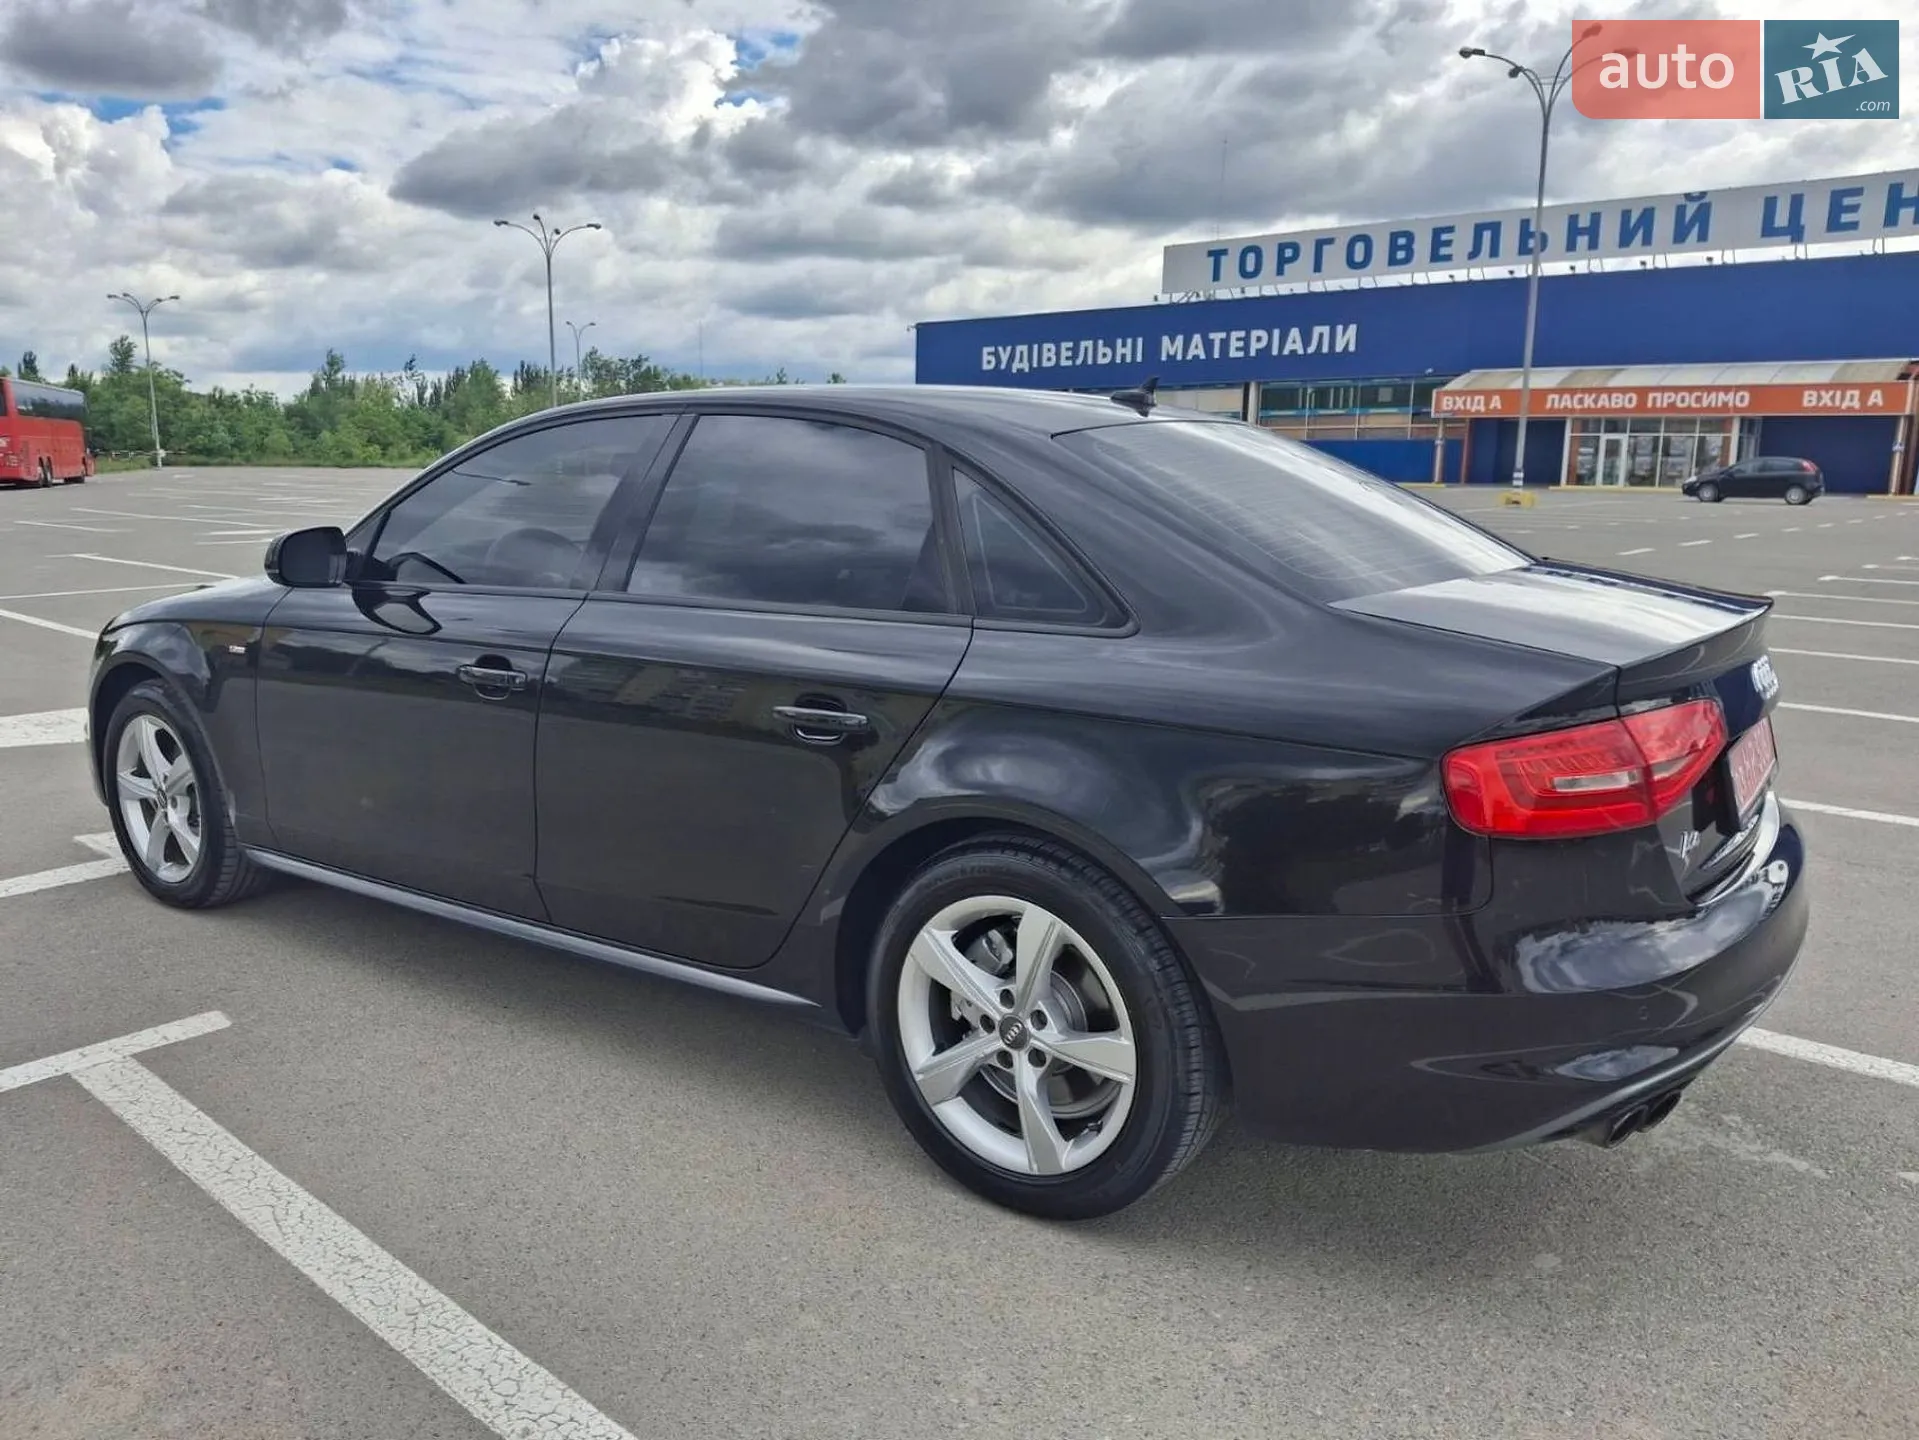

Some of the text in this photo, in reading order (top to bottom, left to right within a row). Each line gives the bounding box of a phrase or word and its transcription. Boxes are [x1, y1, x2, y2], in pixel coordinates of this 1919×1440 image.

[1207, 191, 1712, 282] ТОРГОВЕЛЬНИЙ
[982, 324, 1358, 373] БУДІВЕЛЬНІ МАТЕРІАЛИ
[1443, 395, 1502, 412] ВХІД А
[1546, 391, 1750, 409] ЛАСКАВО ПРОСИМО
[1802, 389, 1884, 410] ВХІД А
